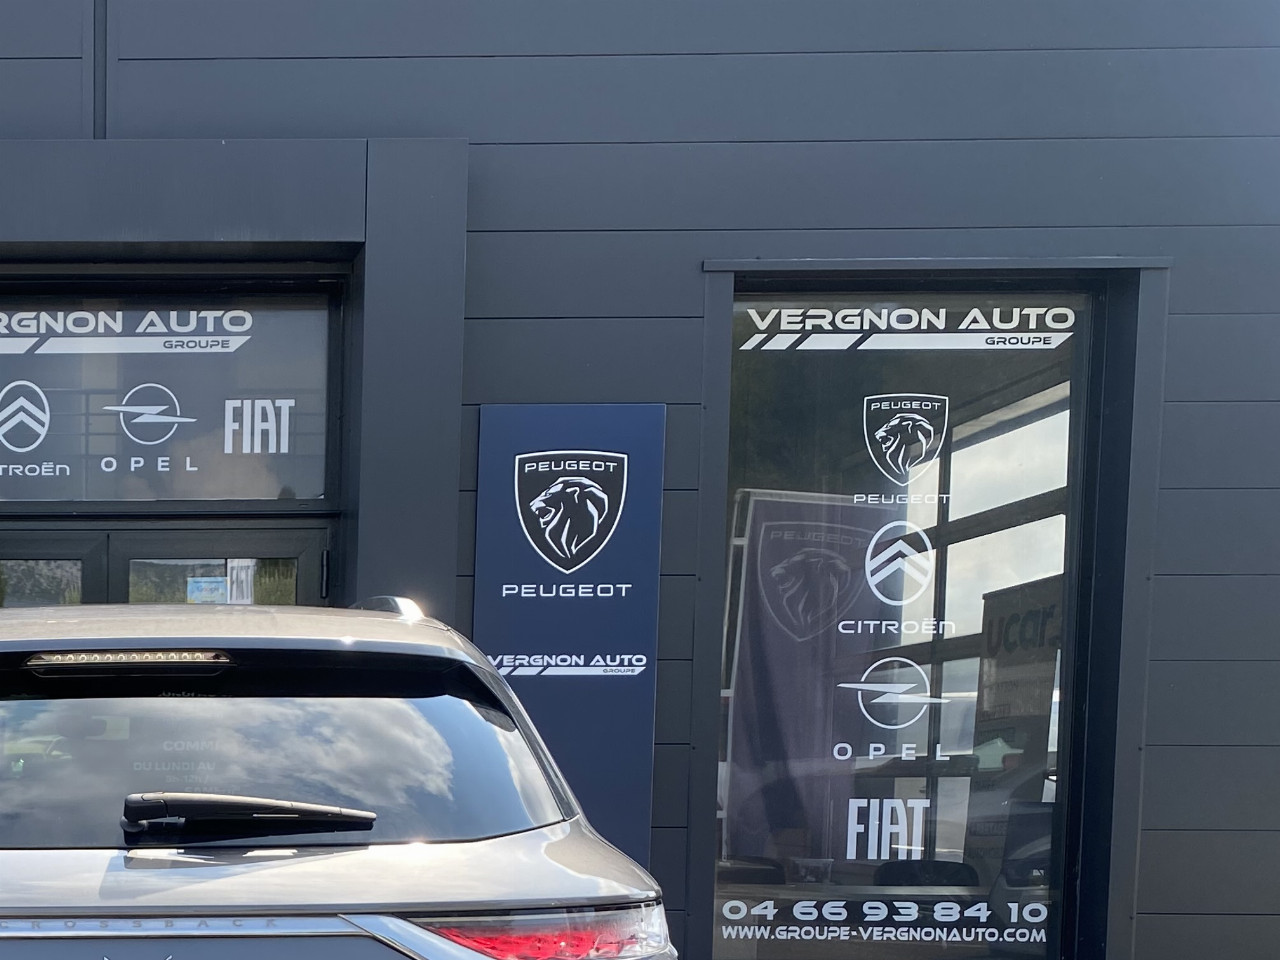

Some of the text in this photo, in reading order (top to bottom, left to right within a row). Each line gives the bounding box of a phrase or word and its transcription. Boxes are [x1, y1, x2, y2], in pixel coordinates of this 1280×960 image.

[136, 309, 253, 334] AUTO
[747, 307, 1075, 331] VERGNON AUTO
[162, 340, 230, 350] GROUPE
[985, 336, 1052, 346] GROUPE
[870, 400, 941, 411] PEUGEOT
[223, 398, 296, 454] FIAT
[100, 456, 198, 472] OPEL
[524, 460, 618, 473] PEUGEOT
[853, 493, 951, 504] PEUGEOT
[502, 583, 633, 598] PEUGEOT
[487, 654, 647, 666] VERGNON AUTO
[833, 742, 951, 761] OPEL
[846, 798, 931, 860] FIAT
[722, 900, 1048, 923] 04 66 93 84 10
[721, 925, 1047, 943] WWW.GROUPE-VERGNONAUTO.COM
